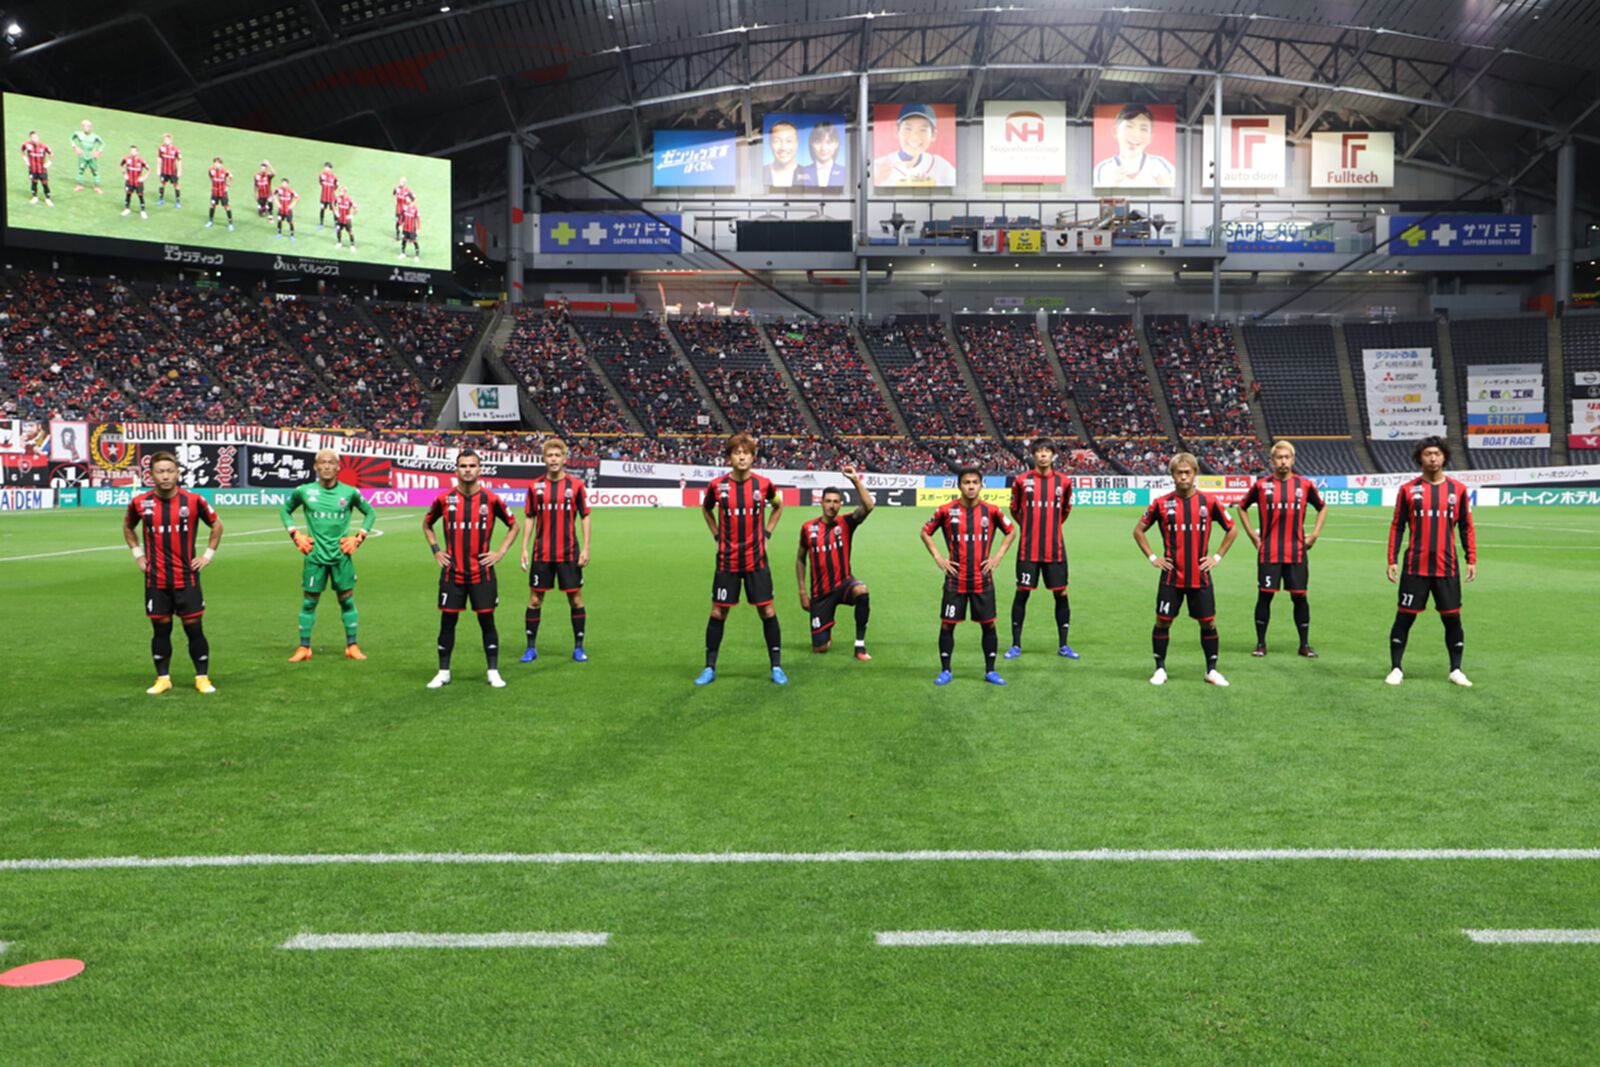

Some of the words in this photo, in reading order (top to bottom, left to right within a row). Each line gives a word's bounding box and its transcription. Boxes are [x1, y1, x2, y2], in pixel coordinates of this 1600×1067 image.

[1224, 173, 1250, 181] auto
[1252, 171, 1279, 181] door
[1327, 170, 1378, 183] Fulltech
[613, 222, 671, 236] サツドラ
[1462, 223, 1522, 237] サツドラ
[278, 434, 312, 449] LIVE
[1482, 437, 1508, 446] BOAT
[1509, 436, 1536, 445] RACE
[866, 476, 918, 486] あいプラン
[215, 493, 258, 505] ROUTE
[588, 490, 658, 505] docomo
[533, 574, 539, 586] 3
[1021, 572, 1031, 585] 32
[1265, 576, 1271, 587] 5
[441, 593, 448, 605] 7
[717, 587, 727, 601] 10
[1401, 593, 1414, 607] 27
[945, 604, 955, 617] 18
[1159, 600, 1170, 614] 14
